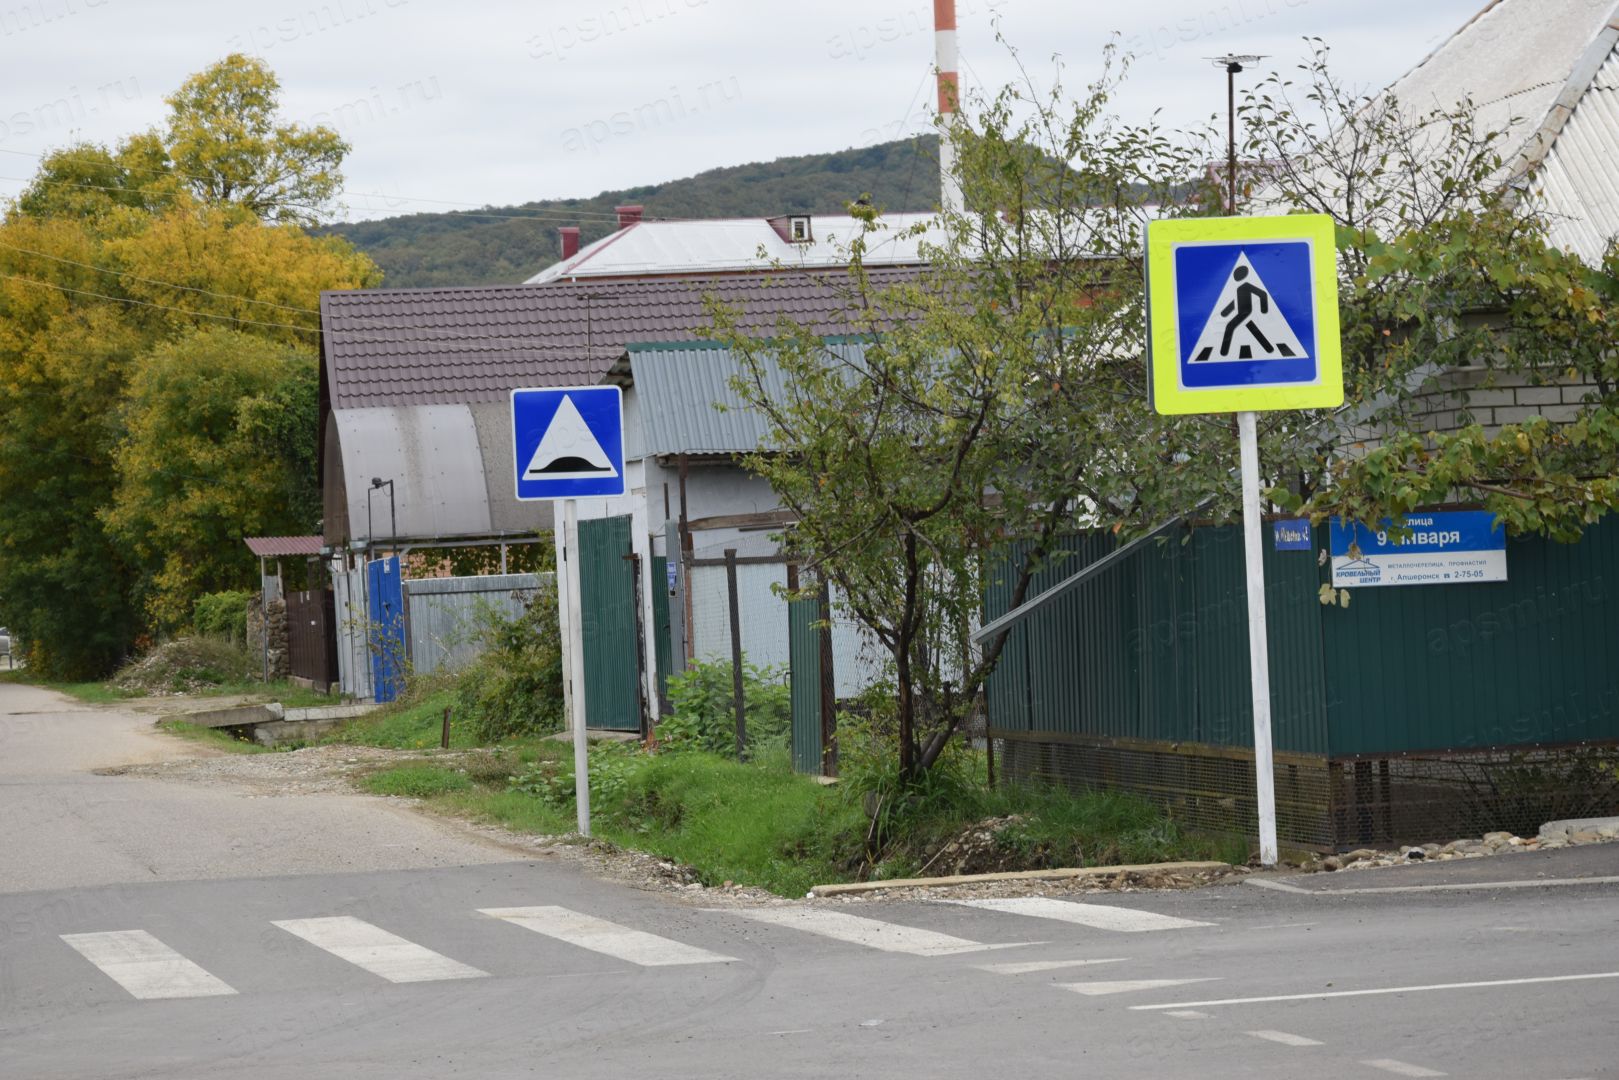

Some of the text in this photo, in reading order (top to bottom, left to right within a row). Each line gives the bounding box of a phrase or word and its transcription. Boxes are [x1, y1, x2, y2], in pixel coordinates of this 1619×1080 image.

[1403, 517, 1434, 528] лица
[1376, 531, 1387, 546] 9
[1397, 573, 1440, 582] Апшеронск
[1454, 569, 1484, 578] 2-75-05
